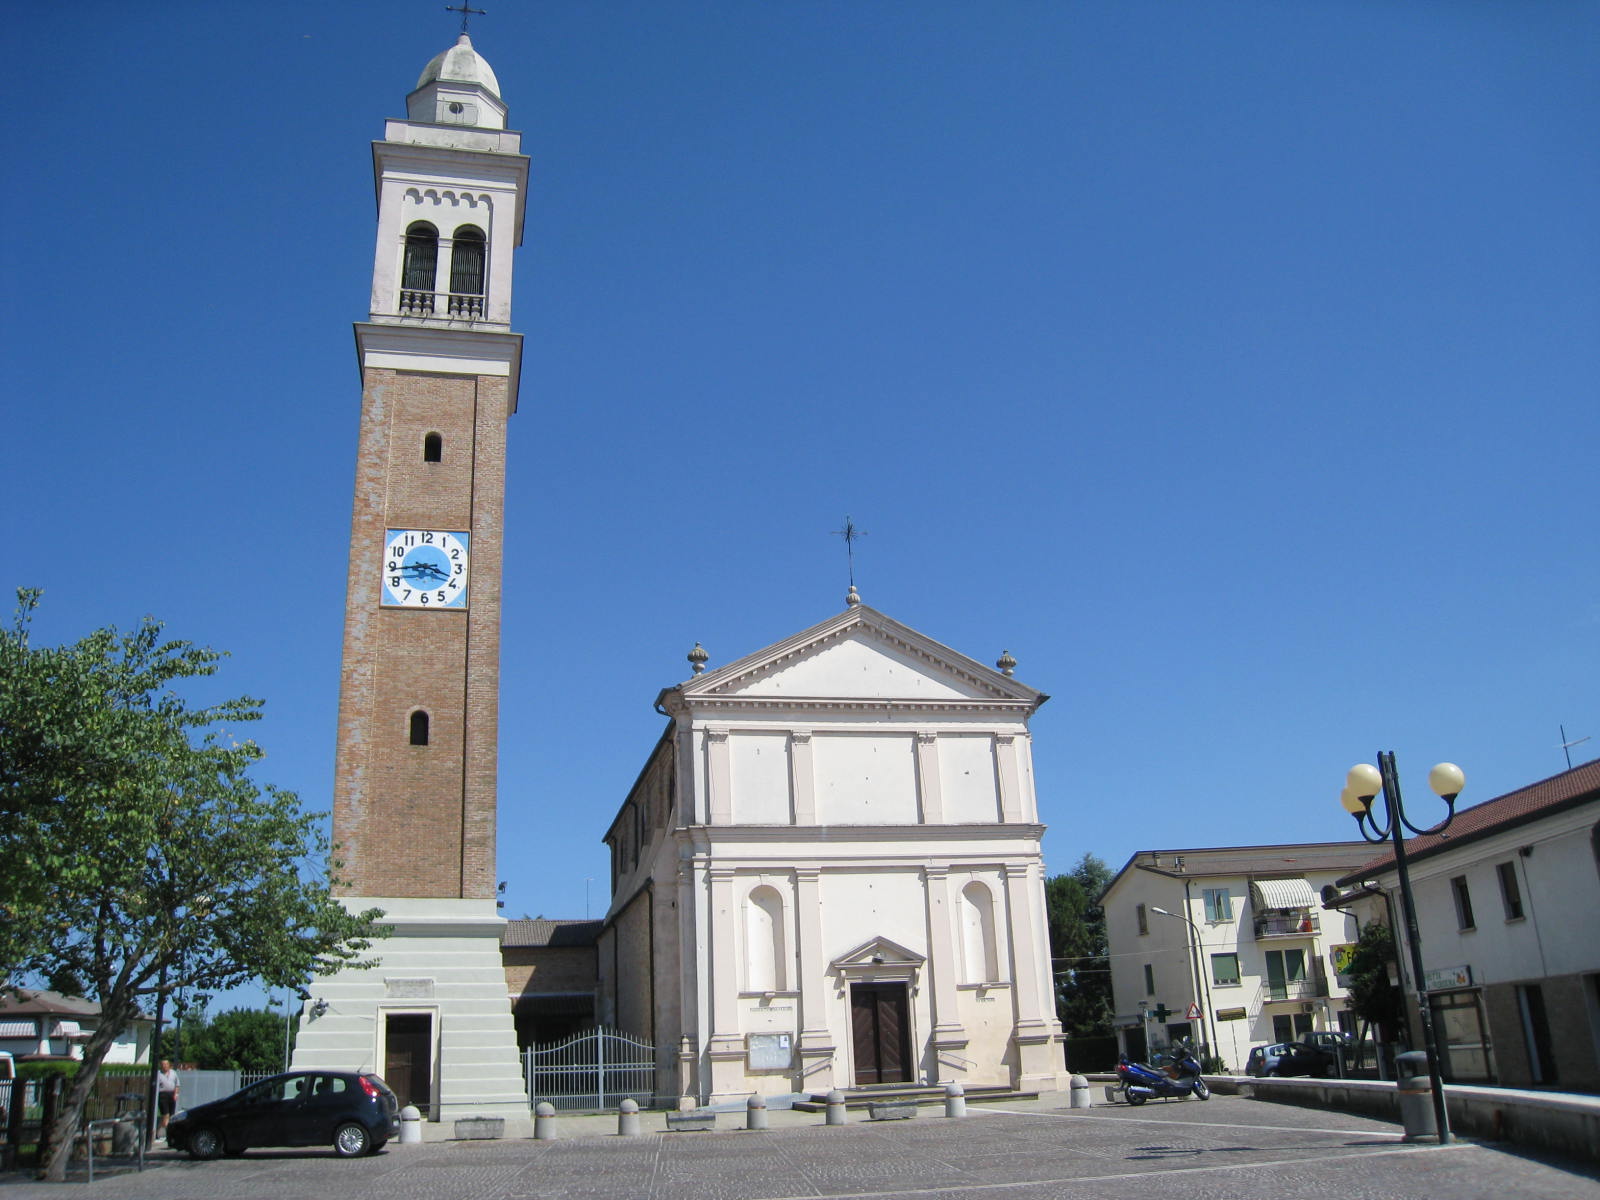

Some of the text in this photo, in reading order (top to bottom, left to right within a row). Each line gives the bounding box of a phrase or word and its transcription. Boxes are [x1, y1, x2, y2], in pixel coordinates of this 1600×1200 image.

[405, 535, 414, 546] 11
[422, 532, 434, 544] 12
[393, 546, 404, 557] 10
[451, 549, 459, 559] 2
[388, 561, 396, 572] 9
[454, 564, 462, 574] 3
[392, 576, 400, 587] 8
[449, 578, 456, 589] 4
[403, 589, 411, 600] 7
[421, 593, 429, 603] 6
[437, 591, 445, 601] 5
